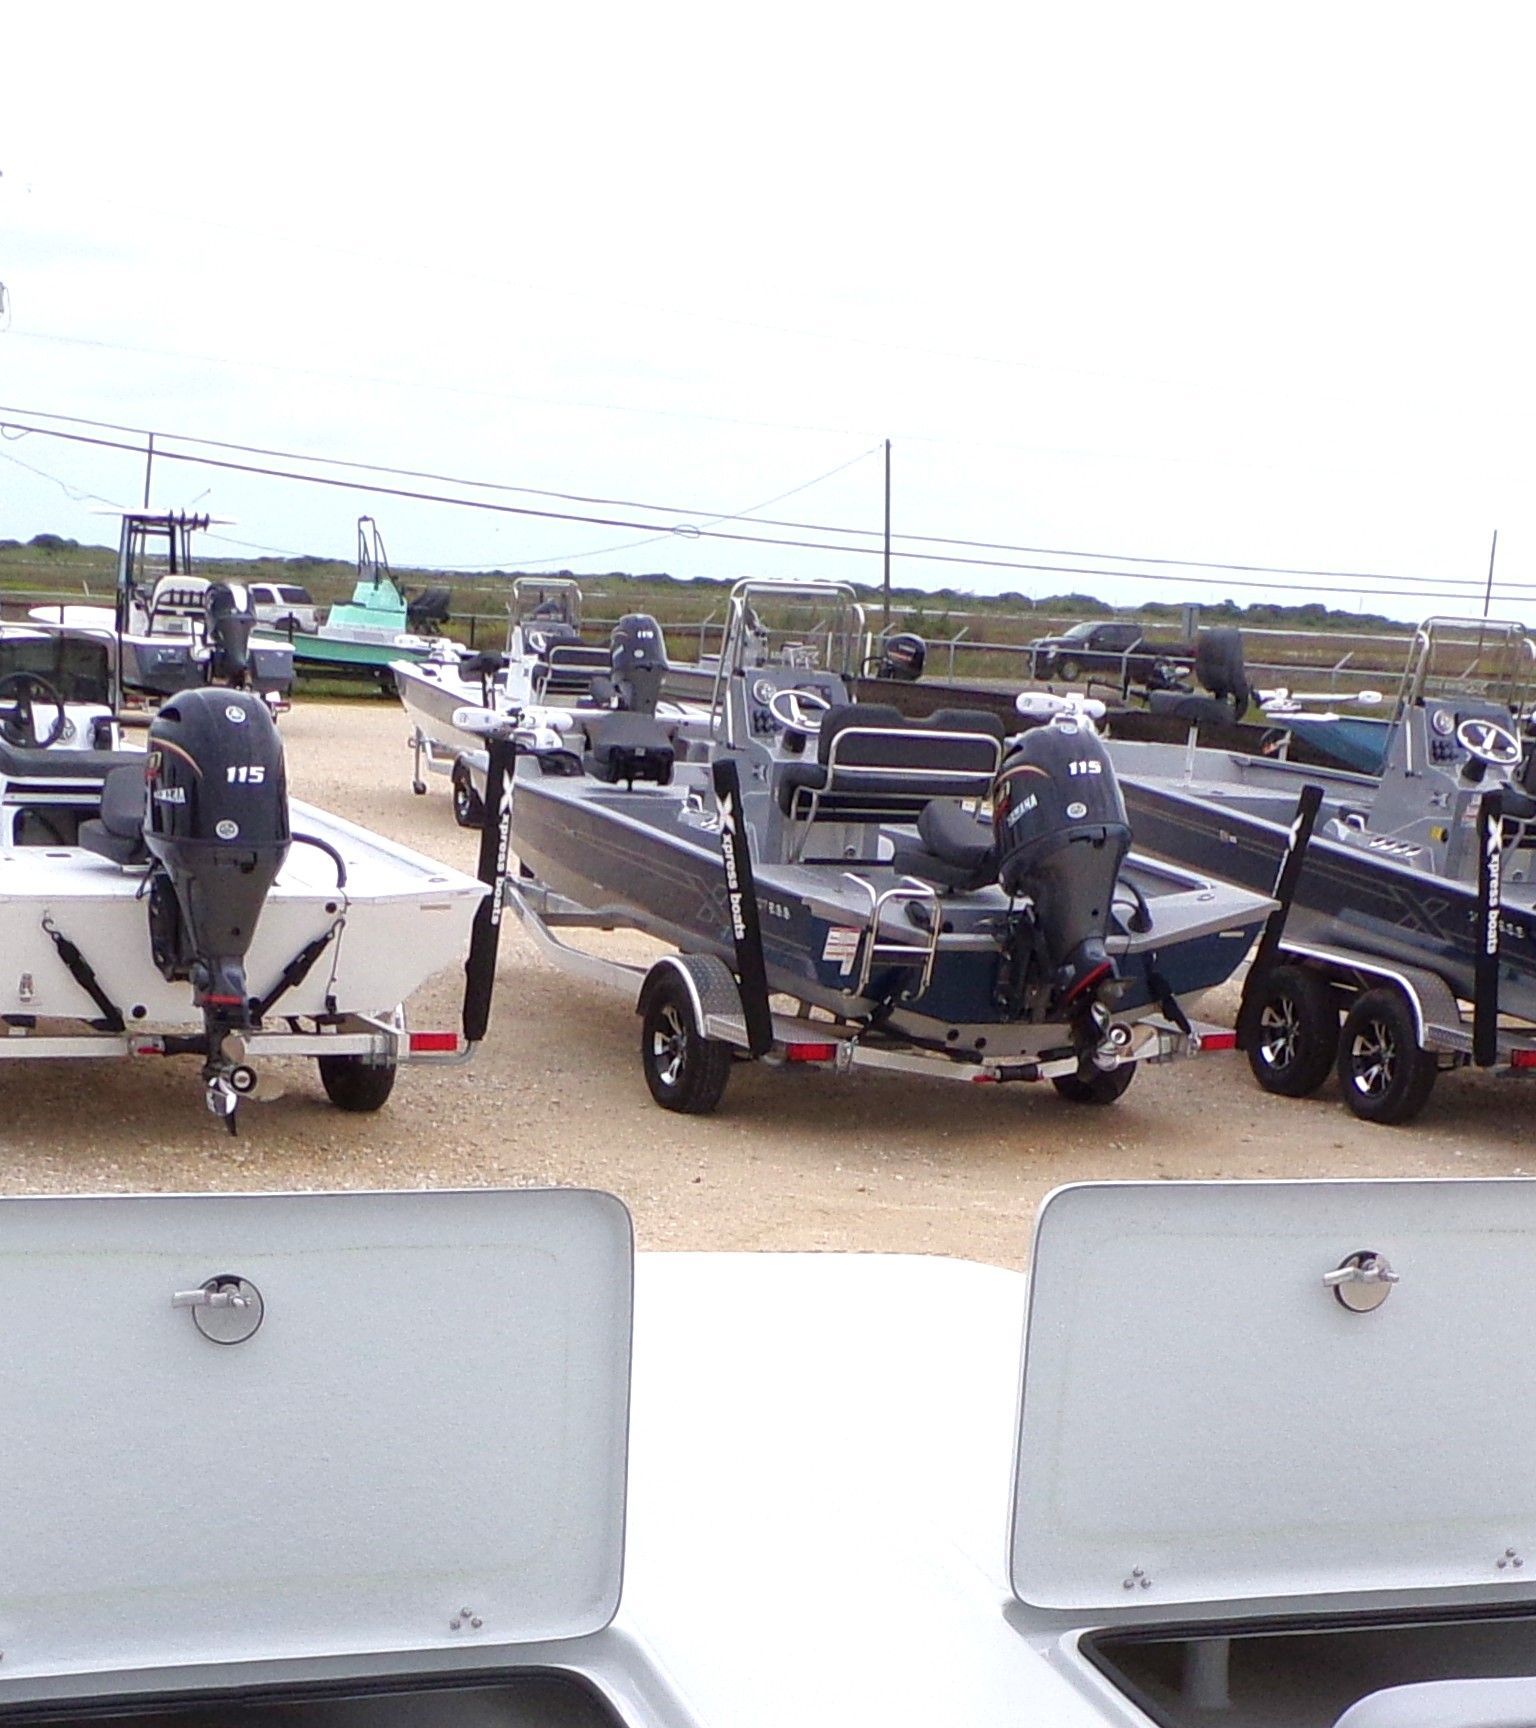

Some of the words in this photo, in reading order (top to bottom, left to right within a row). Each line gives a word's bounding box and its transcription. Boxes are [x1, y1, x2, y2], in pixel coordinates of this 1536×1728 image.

[227, 766, 265, 783] 115
[1069, 760, 1102, 776] 115
[491, 876, 505, 925] boats
[722, 833, 738, 889] xpress
[730, 893, 746, 940] boats
[1487, 853, 1500, 907] xpress
[1486, 910, 1500, 954] boats
